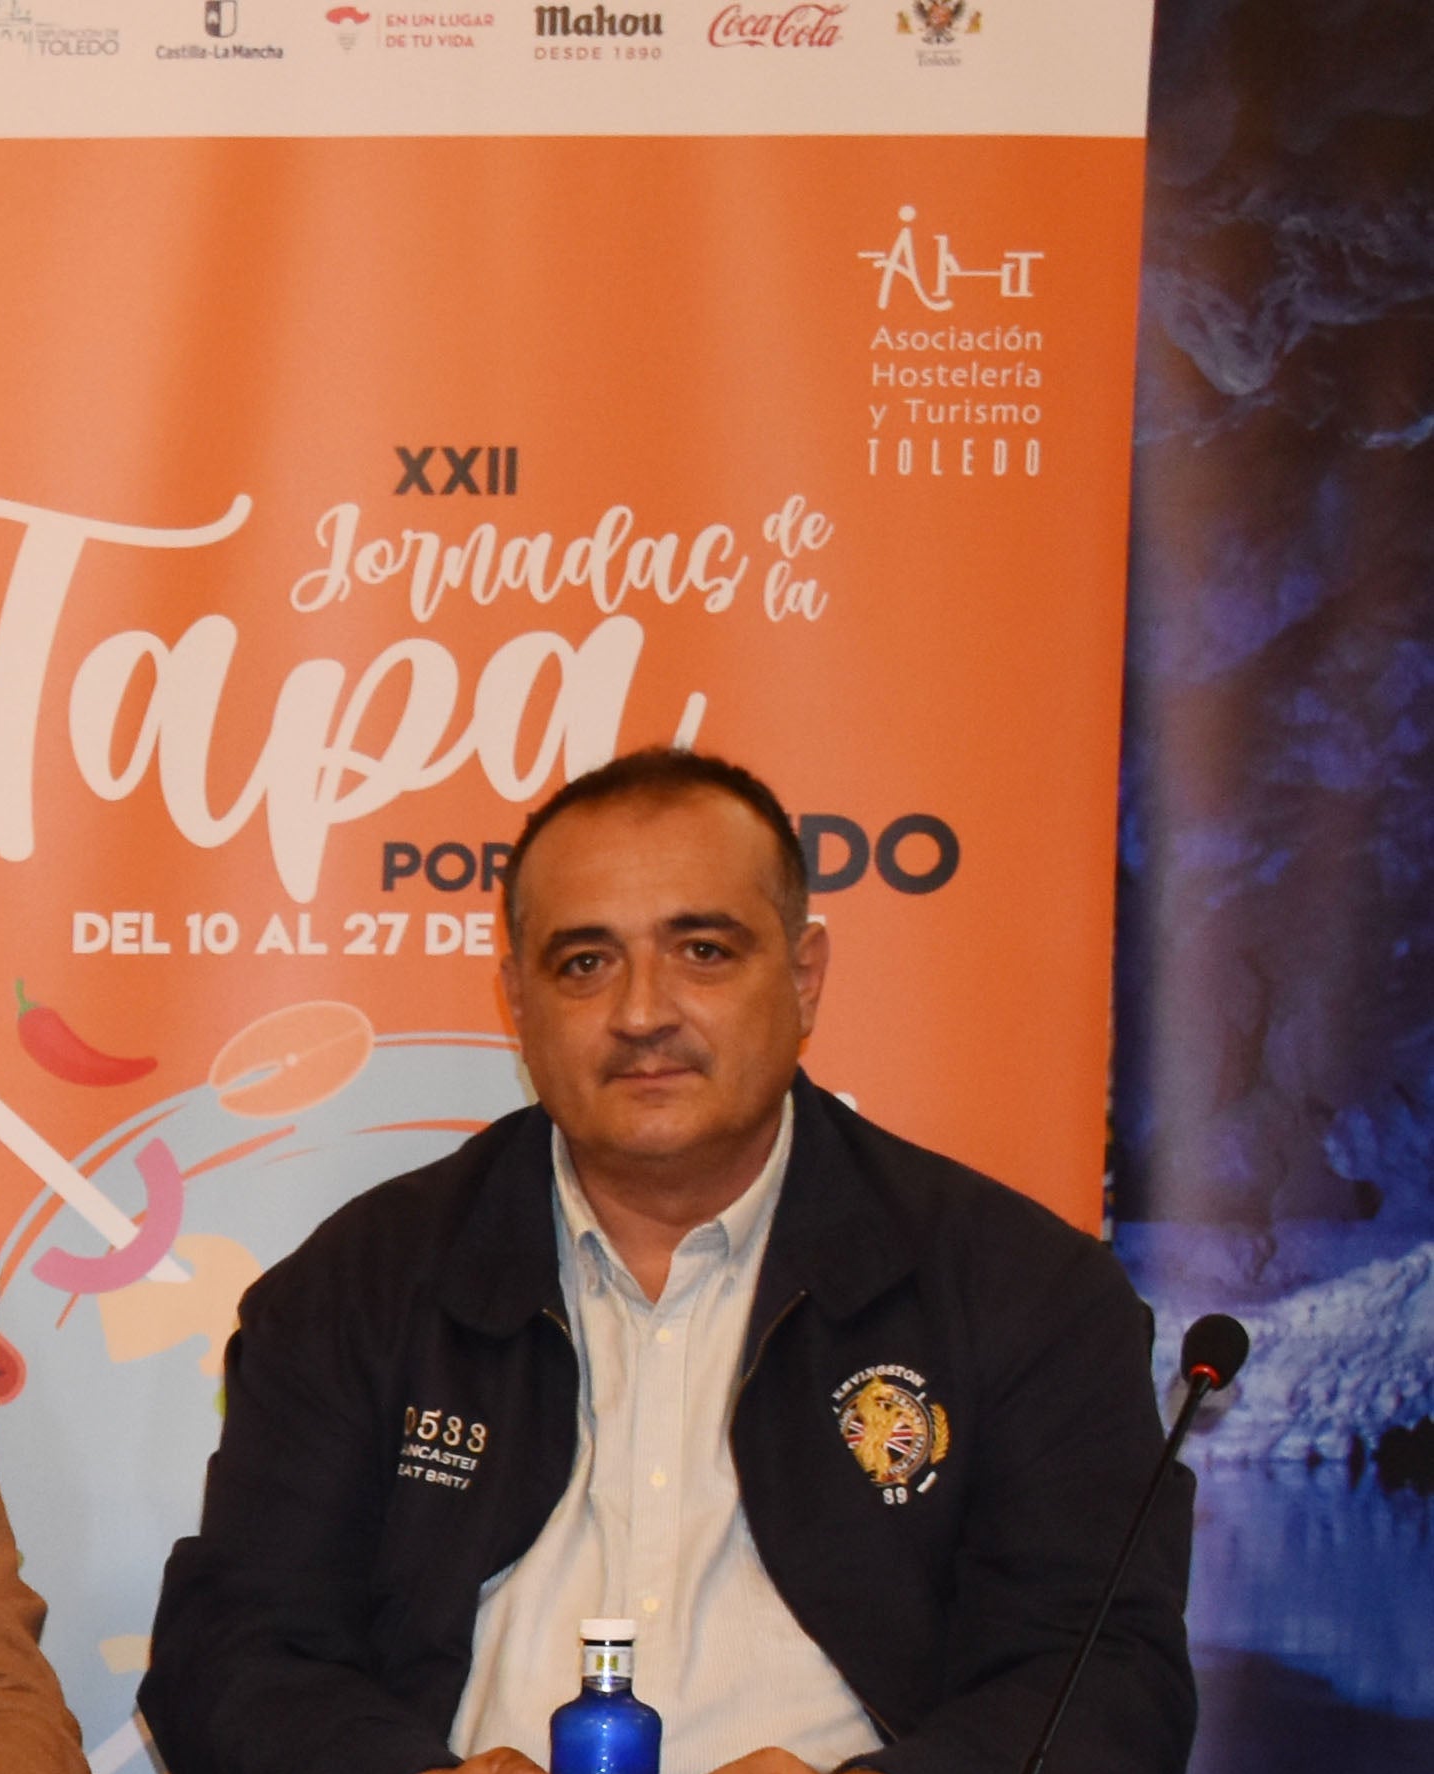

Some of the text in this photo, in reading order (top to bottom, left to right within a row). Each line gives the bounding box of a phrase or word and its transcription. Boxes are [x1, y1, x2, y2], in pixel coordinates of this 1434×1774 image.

[386, 13, 494, 27] EN UN LUGAR
[534, 4, 663, 37] Mahou
[707, 3, 848, 48] Coca-Cola
[38, 39, 119, 56] TOLEDO
[232, 45, 283, 59] Mancha
[386, 34, 474, 48] DE TU VIDA
[534, 46, 662, 60] DESDE 1890
[870, 325, 1042, 351] Asociación
[872, 361, 1041, 387] Hostelería
[869, 398, 1041, 430] y Turismo
[396, 447, 518, 495] XXII
[868, 438, 1040, 476] TOLEDO
[291, 494, 833, 623] Jornadas de
[763, 559, 829, 622] la
[381, 840, 514, 893] POR
[73, 912, 494, 955] DEL 10 AL 27 DE
